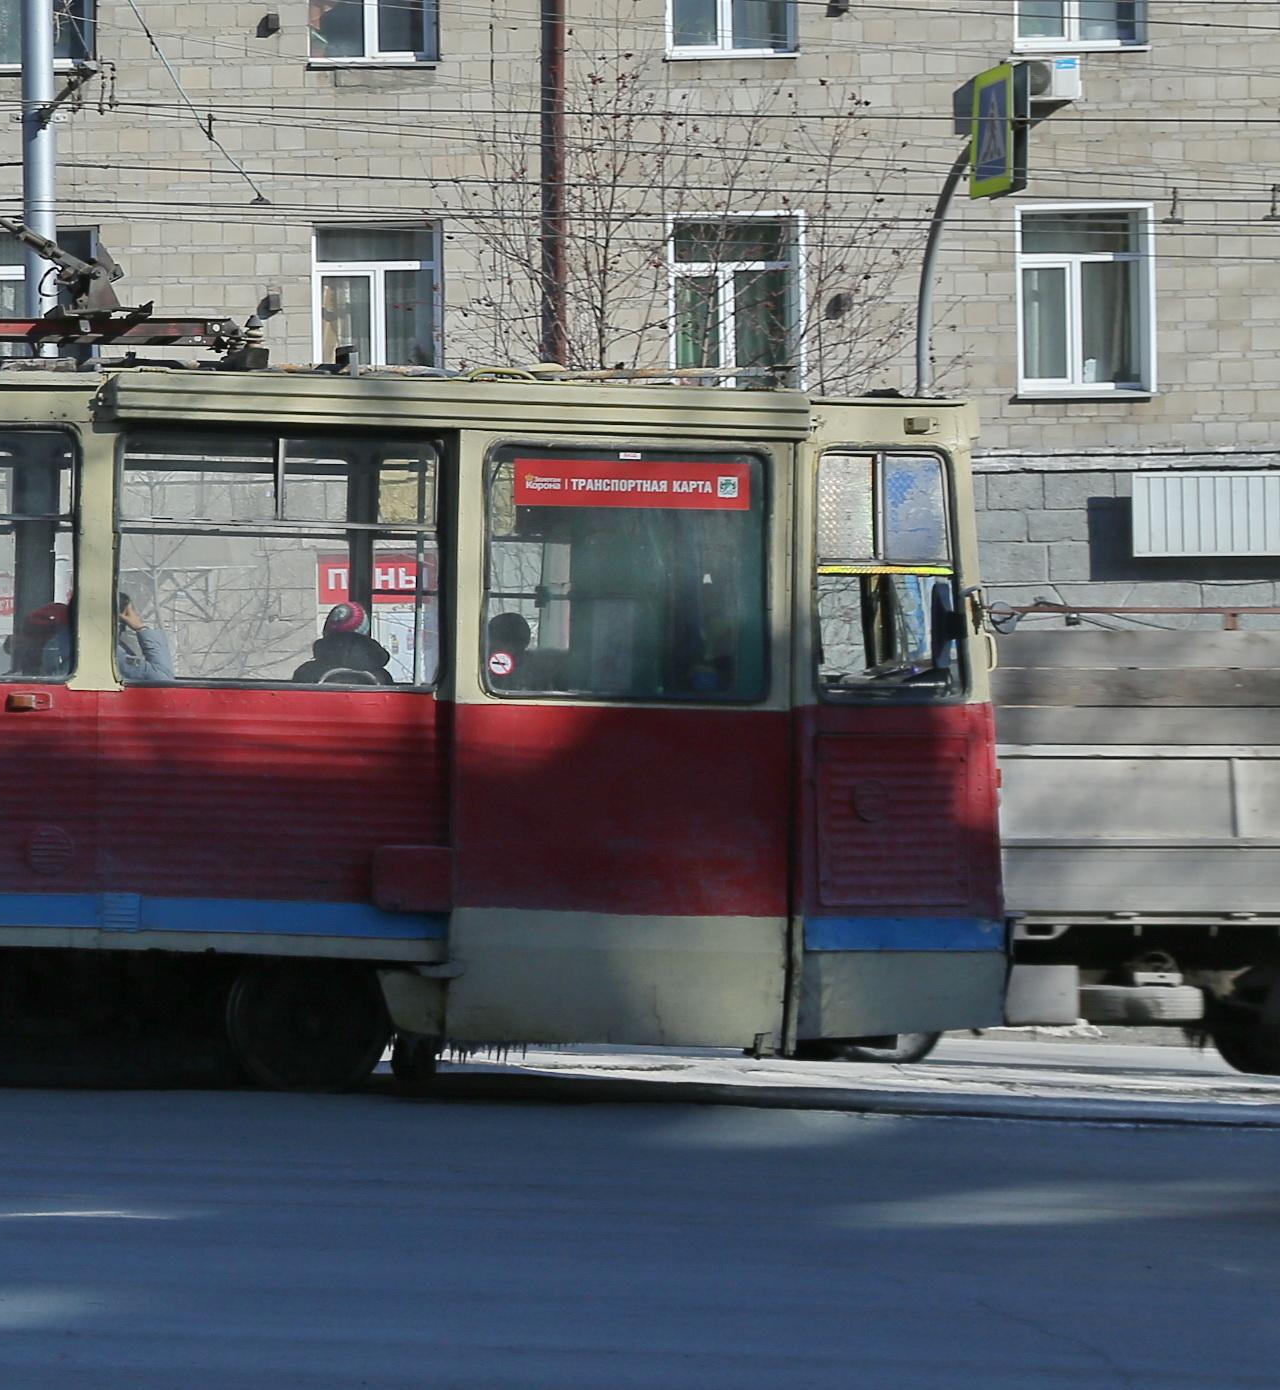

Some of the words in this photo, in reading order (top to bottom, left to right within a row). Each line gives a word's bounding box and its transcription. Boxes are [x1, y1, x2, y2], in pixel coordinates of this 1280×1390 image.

[525, 480, 561, 491] Корона
[571, 478, 668, 492] ТРАНСПОРТНАЯ
[672, 480, 712, 493] КАРТА
